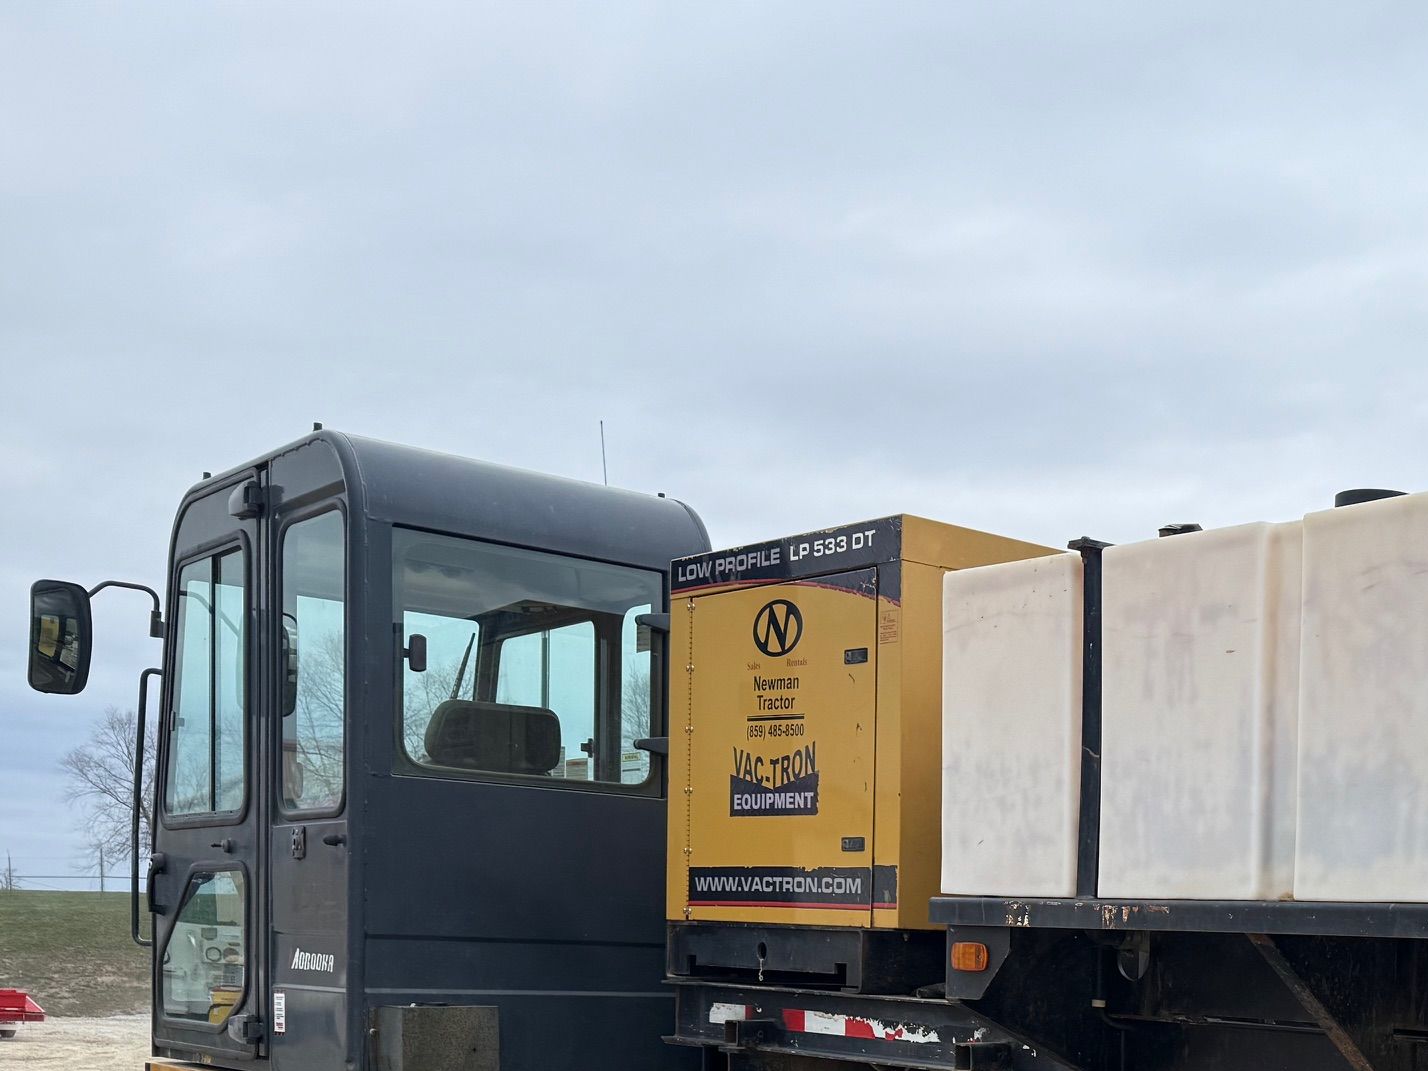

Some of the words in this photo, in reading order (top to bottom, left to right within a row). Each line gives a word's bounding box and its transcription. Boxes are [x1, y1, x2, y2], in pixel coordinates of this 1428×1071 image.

[678, 561, 712, 582] LOW
[715, 548, 780, 575] PROFILE
[790, 542, 810, 562] LP
[814, 535, 847, 557] 533
[852, 529, 876, 550] DT
[747, 661, 761, 671] Sales
[786, 658, 808, 668] Rentals
[753, 675, 799, 692] Newman
[756, 695, 796, 711] Tractor
[746, 724, 766, 741] (859)
[768, 723, 805, 738] 485-8500
[733, 740, 816, 789] VAC-TRON
[733, 791, 814, 810] EQUIPMENT
[695, 876, 862, 895] WWW.VACTRON.COM
